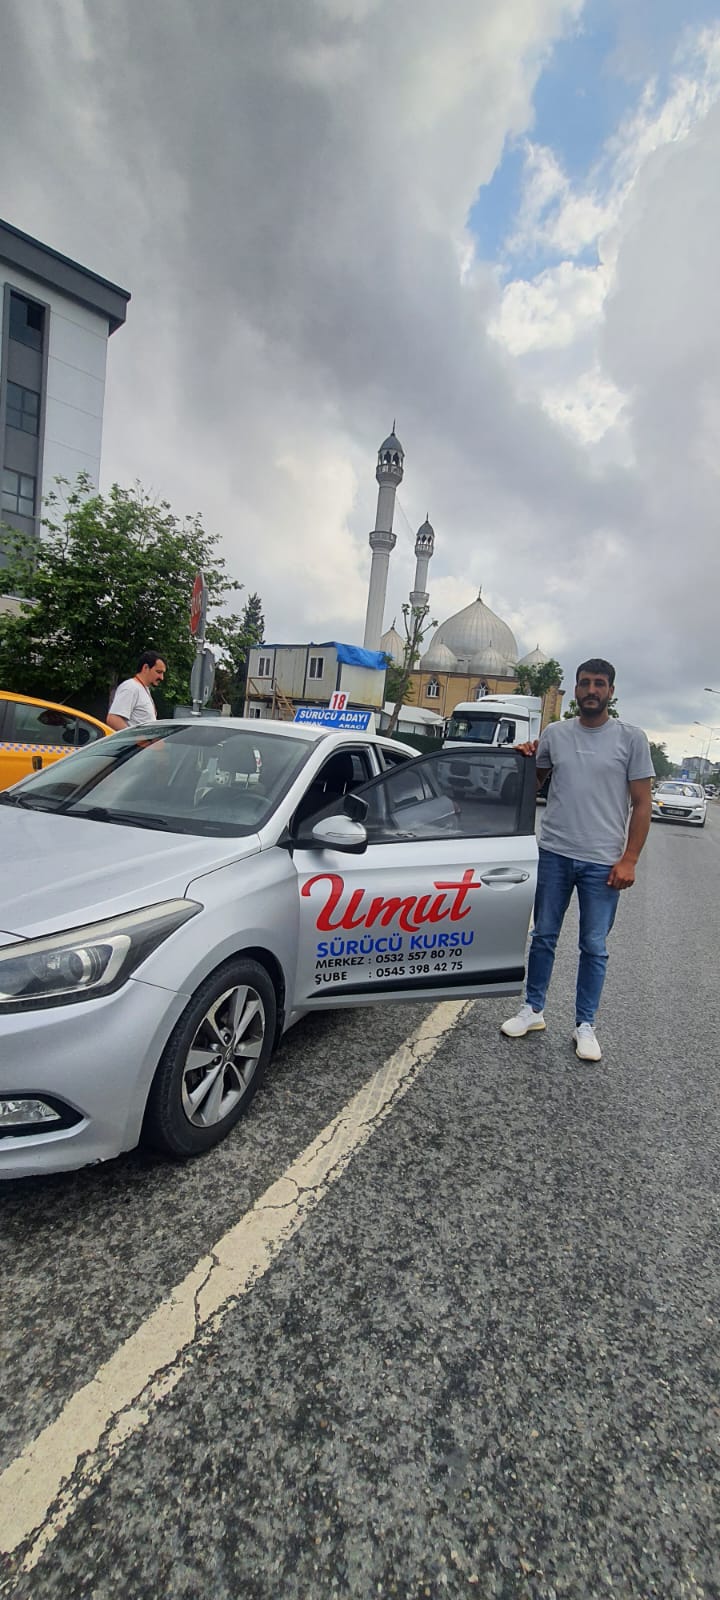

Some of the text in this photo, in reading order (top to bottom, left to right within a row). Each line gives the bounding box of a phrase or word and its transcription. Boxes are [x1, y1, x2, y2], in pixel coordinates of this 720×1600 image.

[332, 693, 347, 710] 18
[299, 709, 369, 723] SÜRÜCÜ ADAYI
[301, 868, 482, 933] Umut
[316, 930, 475, 959] SÜRÜCÜ KURSU
[315, 956, 365, 969] MERKEZ
[375, 953, 404, 964] 0532
[407, 951, 428, 961] 557
[430, 949, 445, 959] 80
[448, 948, 463, 958] 70
[314, 971, 349, 985] ŞUBE
[376, 966, 406, 978] 0545
[408, 964, 430, 974] 398
[433, 962, 448, 972] 42
[450, 961, 463, 971] 75
